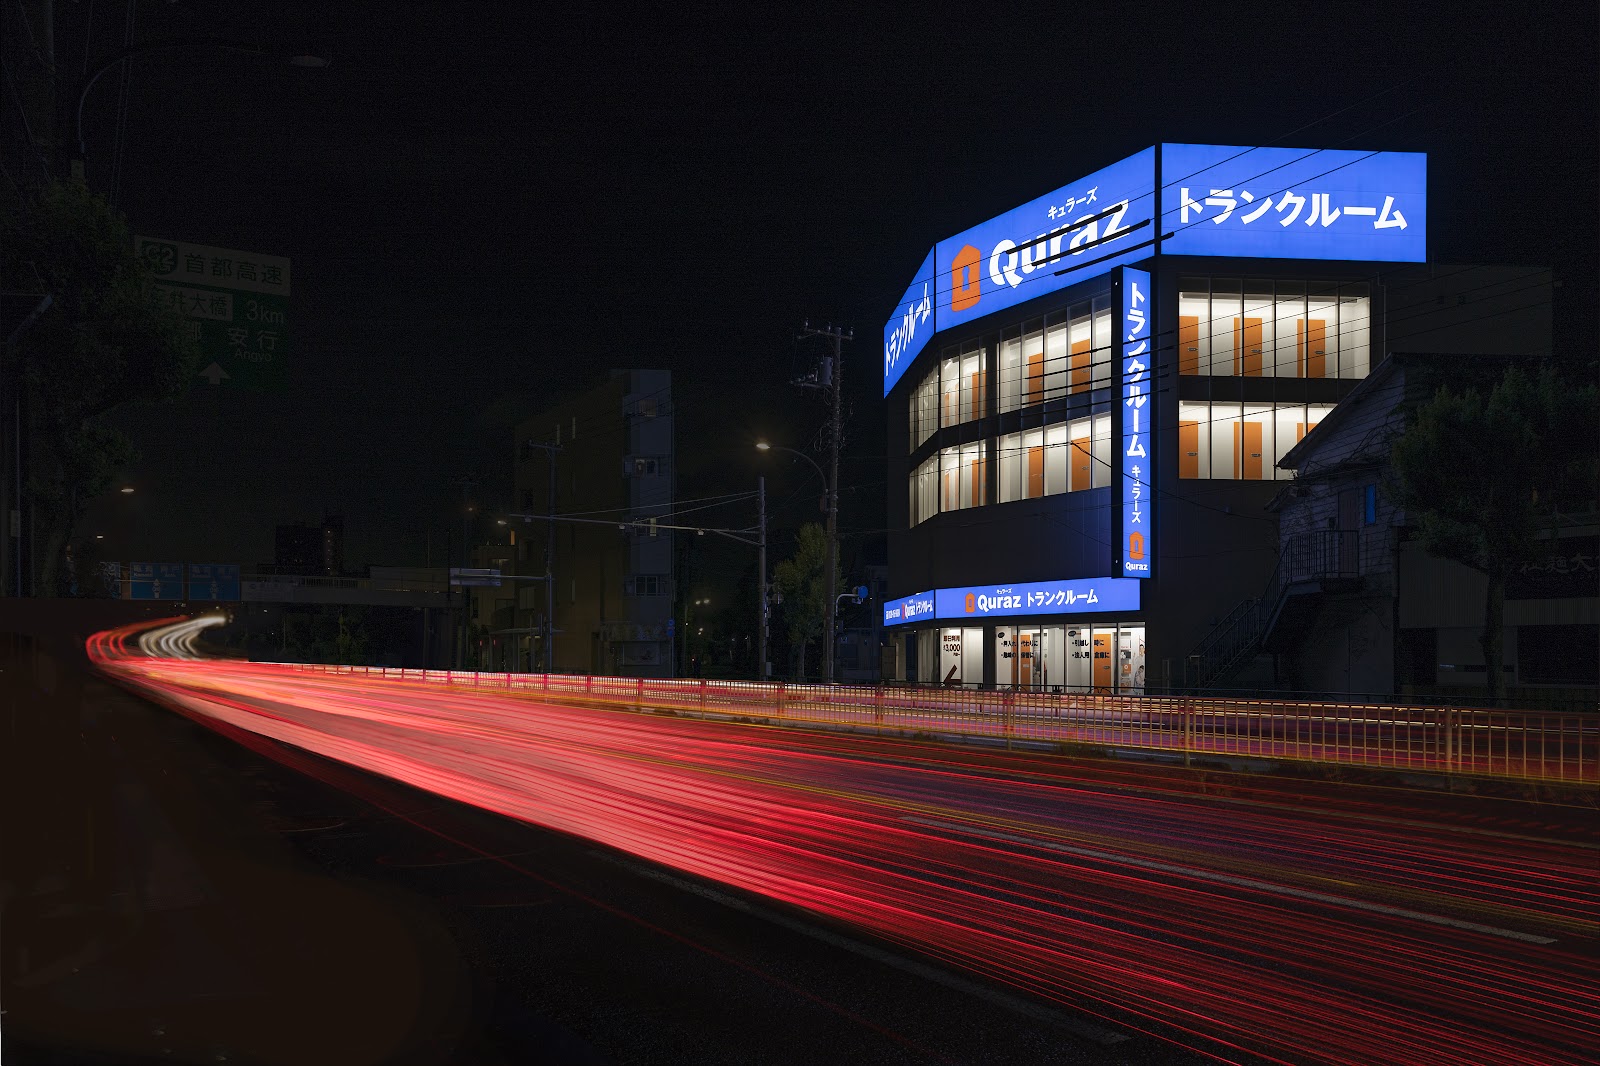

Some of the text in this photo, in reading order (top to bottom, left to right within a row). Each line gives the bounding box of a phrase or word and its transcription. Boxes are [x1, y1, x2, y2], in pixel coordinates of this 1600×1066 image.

[1047, 186, 1098, 220] キュラーズ
[1180, 187, 1408, 230] トランクルーム
[989, 198, 1131, 289] Quraz
[184, 253, 284, 286] 首都高速
[245, 299, 285, 324] 3km
[227, 327, 278, 351] 安行
[885, 282, 931, 376] トランクルーム
[1126, 282, 1147, 458] トランクルーム
[1131, 464, 1142, 523] キュラーズ
[1125, 561, 1149, 572] Quraz
[977, 594, 1022, 613] Quraz
[1027, 588, 1099, 608] トランクルーム
